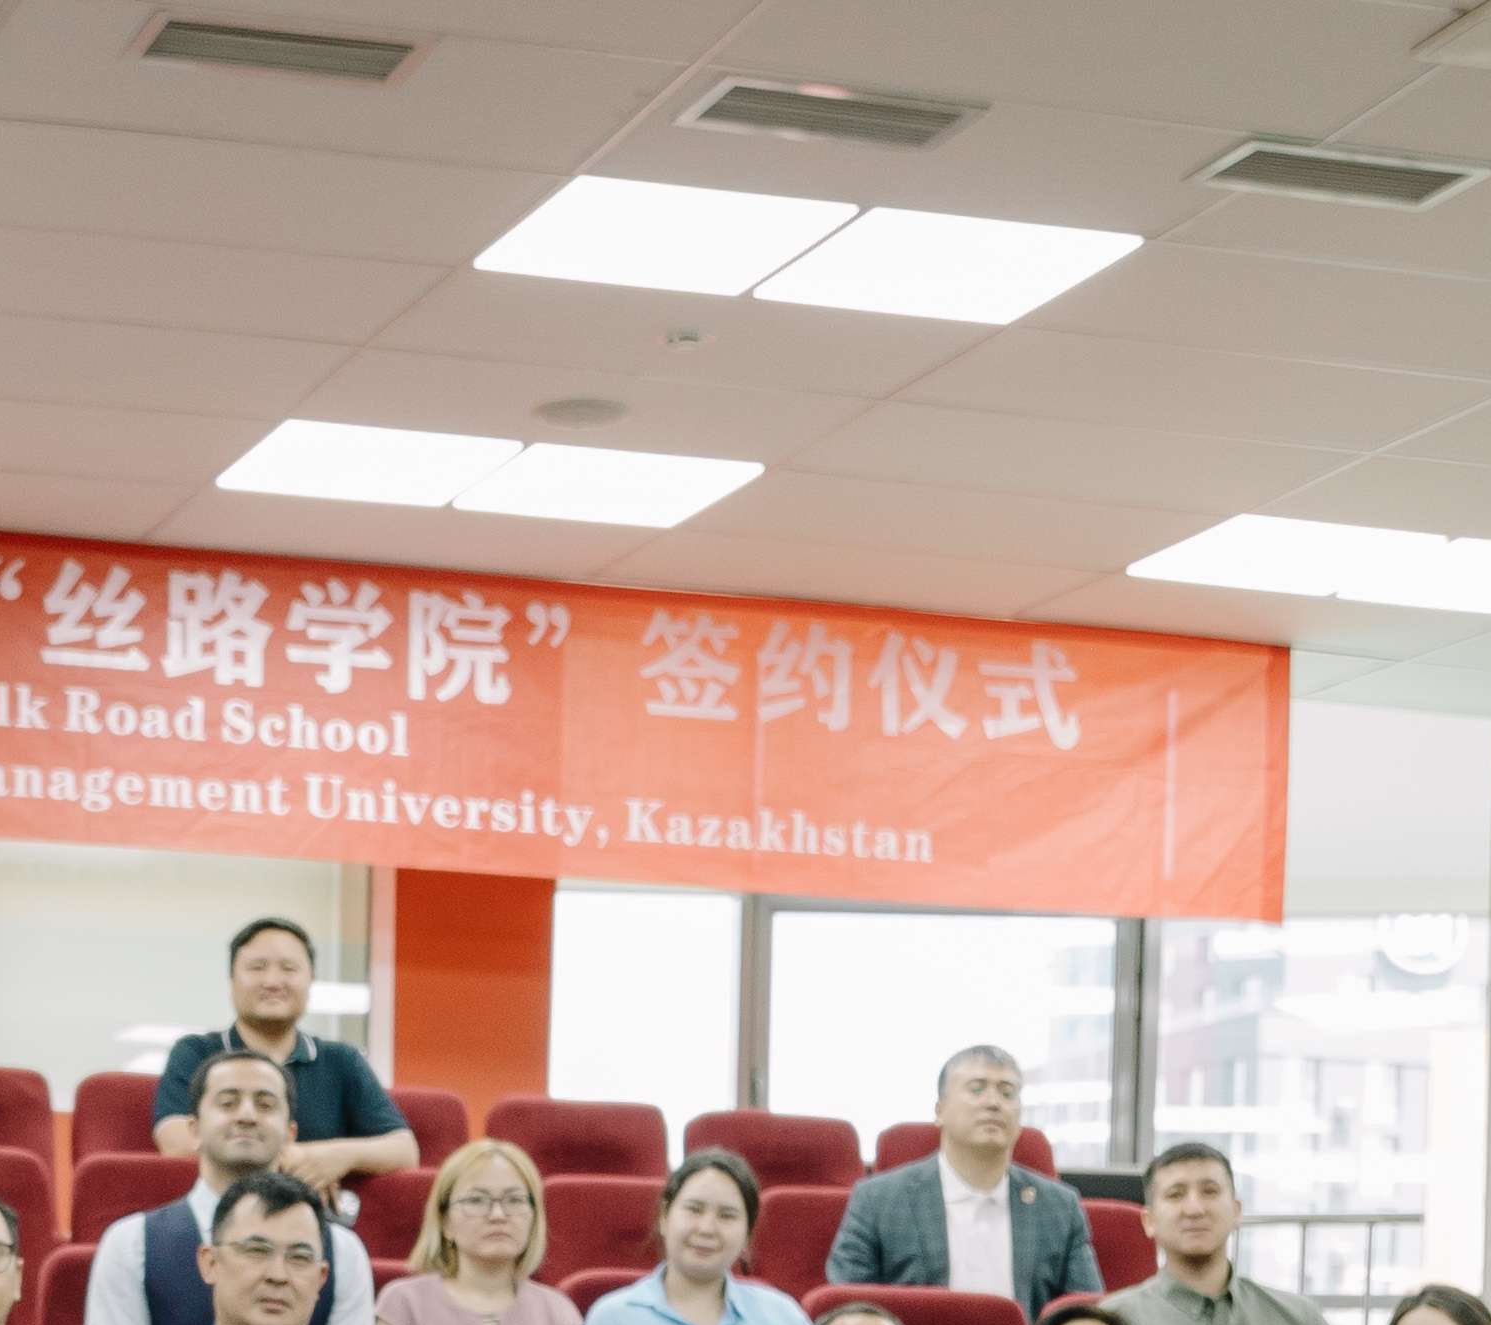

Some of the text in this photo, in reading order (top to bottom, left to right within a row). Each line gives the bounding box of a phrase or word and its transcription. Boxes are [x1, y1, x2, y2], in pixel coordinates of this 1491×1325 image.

[64, 687, 206, 741] Road
[221, 698, 411, 757] School
[304, 772, 611, 848] University,
[624, 797, 932, 863] Kazakhstan
